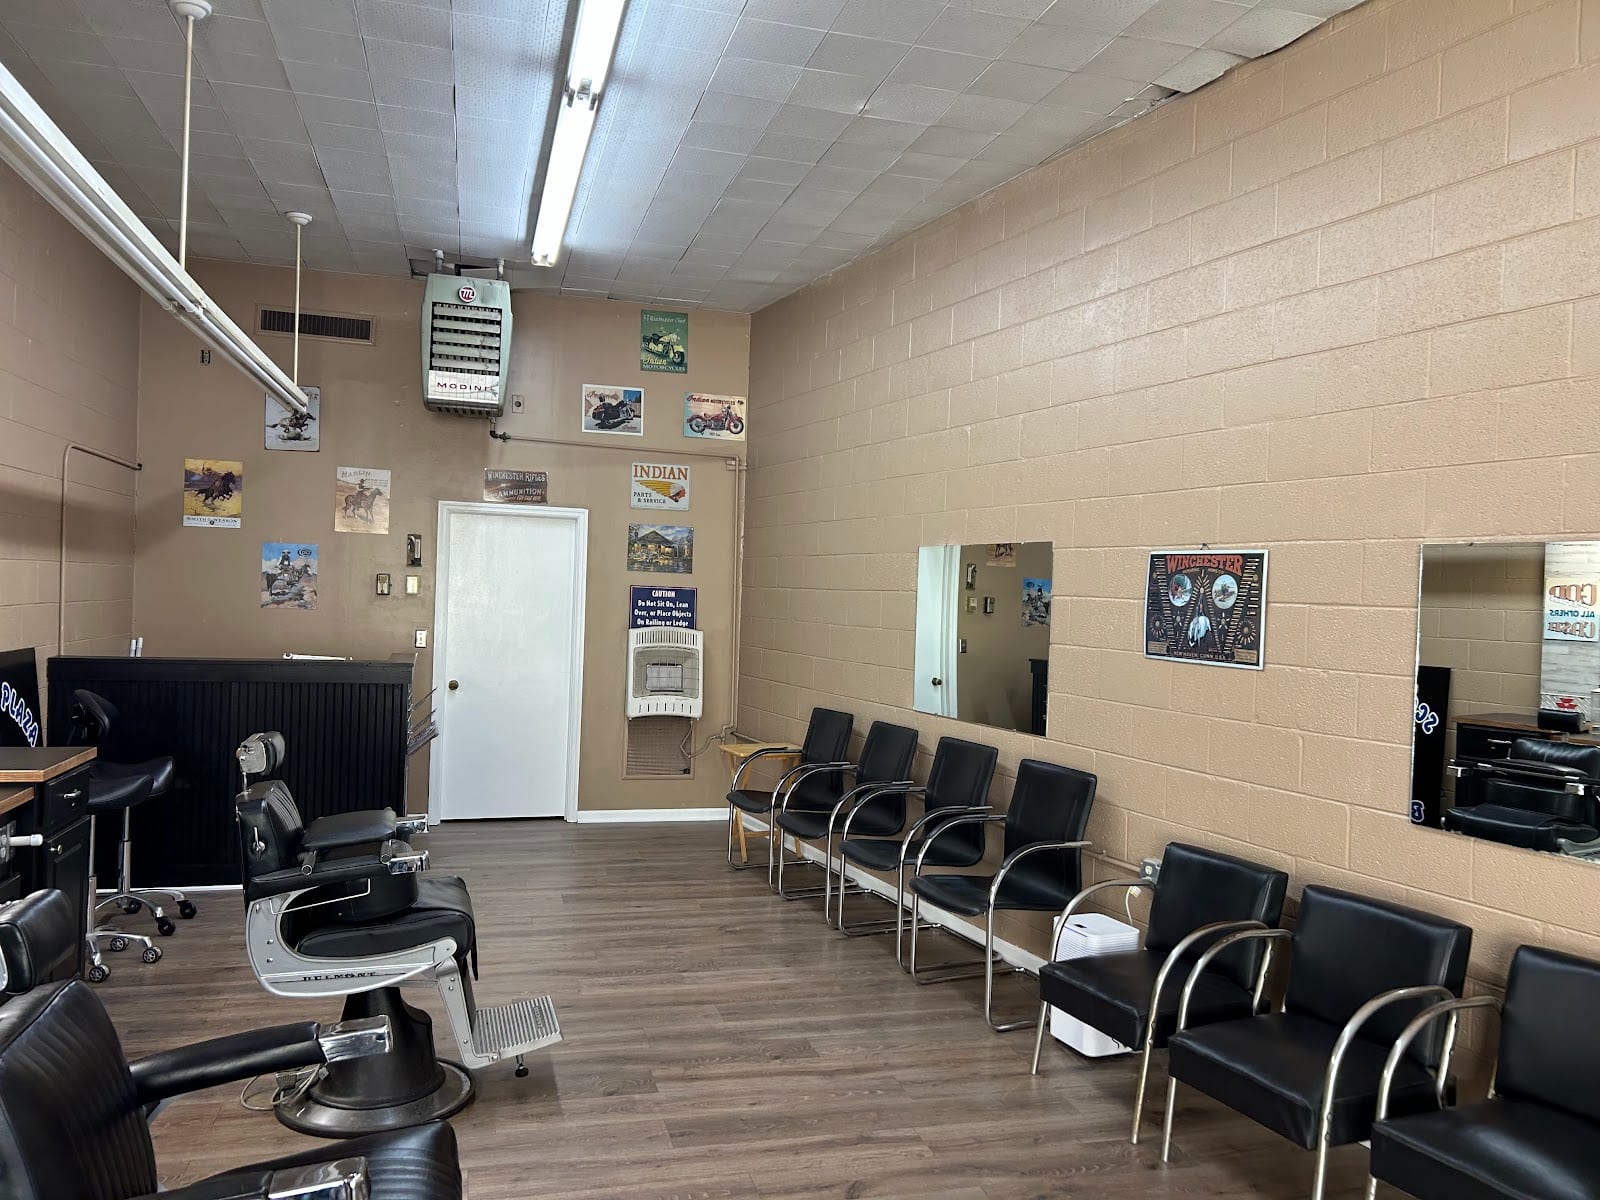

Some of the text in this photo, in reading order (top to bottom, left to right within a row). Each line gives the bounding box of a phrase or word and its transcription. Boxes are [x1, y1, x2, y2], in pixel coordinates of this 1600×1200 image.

[642, 364, 686, 372] MOTORCYCLES
[487, 471, 546, 482] WINCHESTER RIFLES
[633, 464, 689, 481] INDIAN
[497, 488, 542, 497] AMMUNITION
[1166, 554, 1244, 577] WINCHESTER
[651, 590, 676, 598] CAUTION
[637, 599, 646, 607] Do
[665, 600, 675, 608] On,
[634, 608, 649, 617] Over,
[656, 609, 671, 617] Place
[672, 610, 692, 618] Objects
[645, 618, 665, 626] Railing
[673, 619, 689, 627] Ledge
[0, 681, 39, 748] PLAZA
